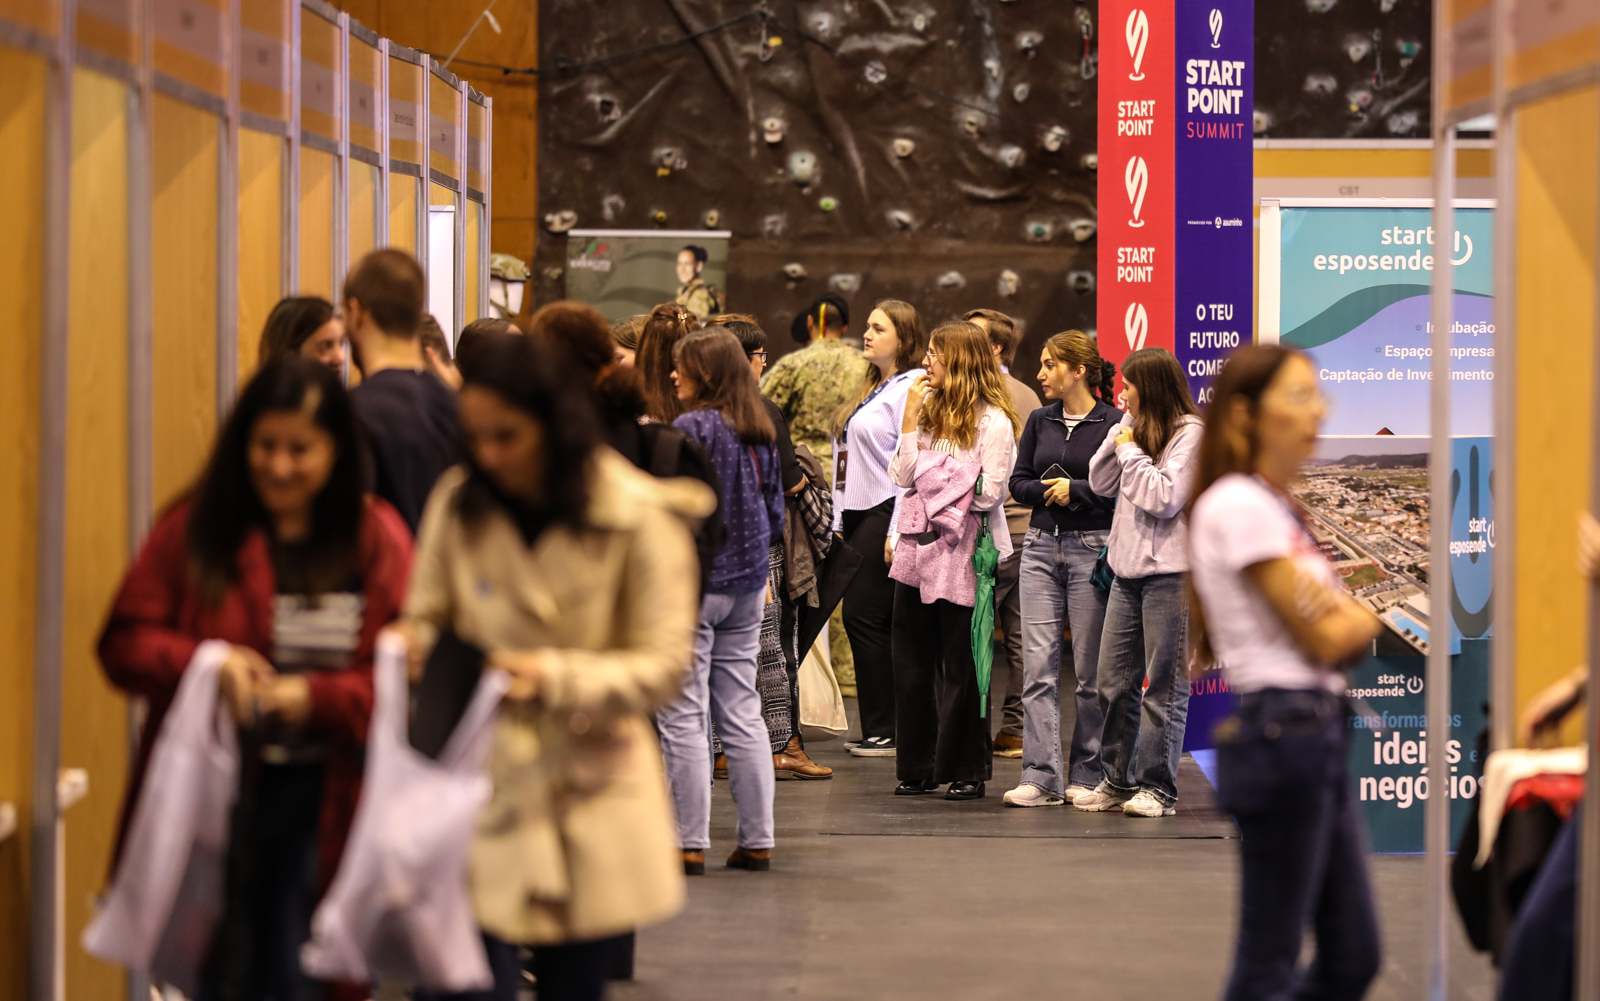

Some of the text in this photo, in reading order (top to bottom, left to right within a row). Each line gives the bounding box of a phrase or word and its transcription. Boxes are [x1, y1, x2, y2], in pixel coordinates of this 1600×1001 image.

[1186, 59, 1245, 86] START
[1117, 100, 1155, 117] START
[1187, 88, 1244, 115] POINT
[1117, 119, 1154, 137] POINT
[1186, 121, 1244, 139] SUMMIT
[1338, 185, 1360, 196] CST
[1381, 226, 1436, 245] start
[1117, 247, 1155, 264] START
[1313, 249, 1436, 275] esposende
[1117, 266, 1153, 283] POINT
[1196, 304, 1233, 321] O TEU
[1426, 320, 1496, 337] Iubação
[1190, 331, 1240, 349] FUTURO
[1385, 345, 1496, 360] Espaço mpresa
[1188, 358, 1231, 377] COME
[1319, 367, 1495, 383] Captação de Inveimento
[1468, 517, 1487, 533] start
[1449, 535, 1487, 558] esposende
[1377, 674, 1405, 685] start
[1345, 685, 1405, 699] esposende
[1373, 731, 1462, 765] ideis
